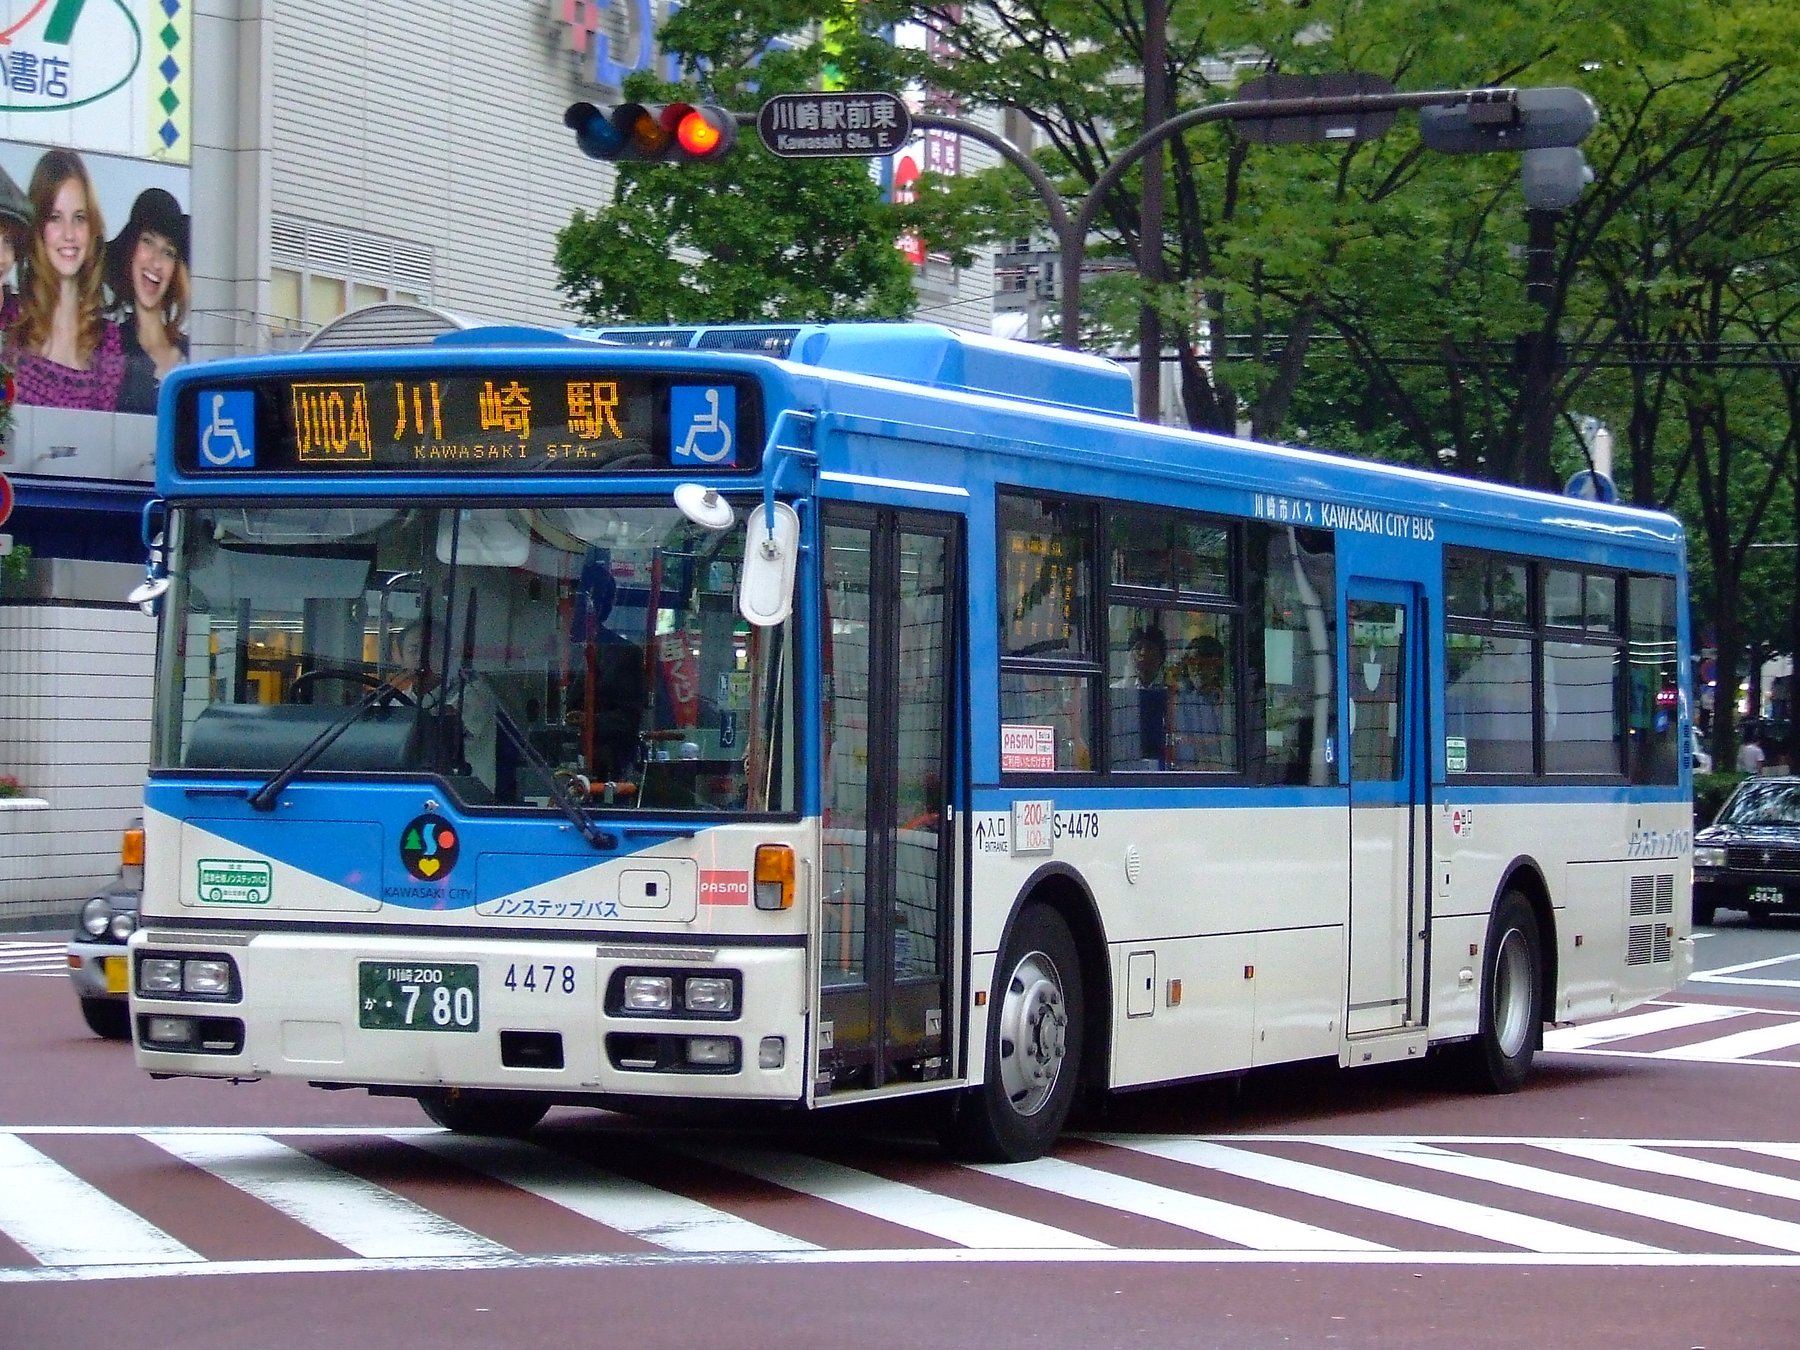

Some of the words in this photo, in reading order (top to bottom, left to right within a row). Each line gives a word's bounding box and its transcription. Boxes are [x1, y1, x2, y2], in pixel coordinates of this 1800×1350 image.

[772, 100, 898, 130] 川崎駅前東
[777, 133, 843, 150] Kawasaki
[877, 132, 893, 148] E.
[393, 381, 623, 440] 川崎駅
[414, 444, 528, 459] KAWASAKI
[547, 443, 597, 459] STA.
[1254, 493, 1313, 523] 川崎市バス
[1321, 502, 1384, 535] KAWASAKI
[1386, 513, 1411, 539] CITY
[1411, 516, 1436, 541] BUS
[1004, 733, 1034, 750] PASMO
[1024, 804, 1042, 826] 200
[987, 818, 1006, 838] 入口
[1053, 812, 1099, 839] S-4478
[384, 886, 446, 900] KAWASAKI
[449, 888, 473, 900] CITY
[701, 882, 747, 894] PASMO
[494, 899, 619, 918] ノンステップバス
[387, 968, 443, 983] 川崎200
[504, 963, 576, 994] 4478
